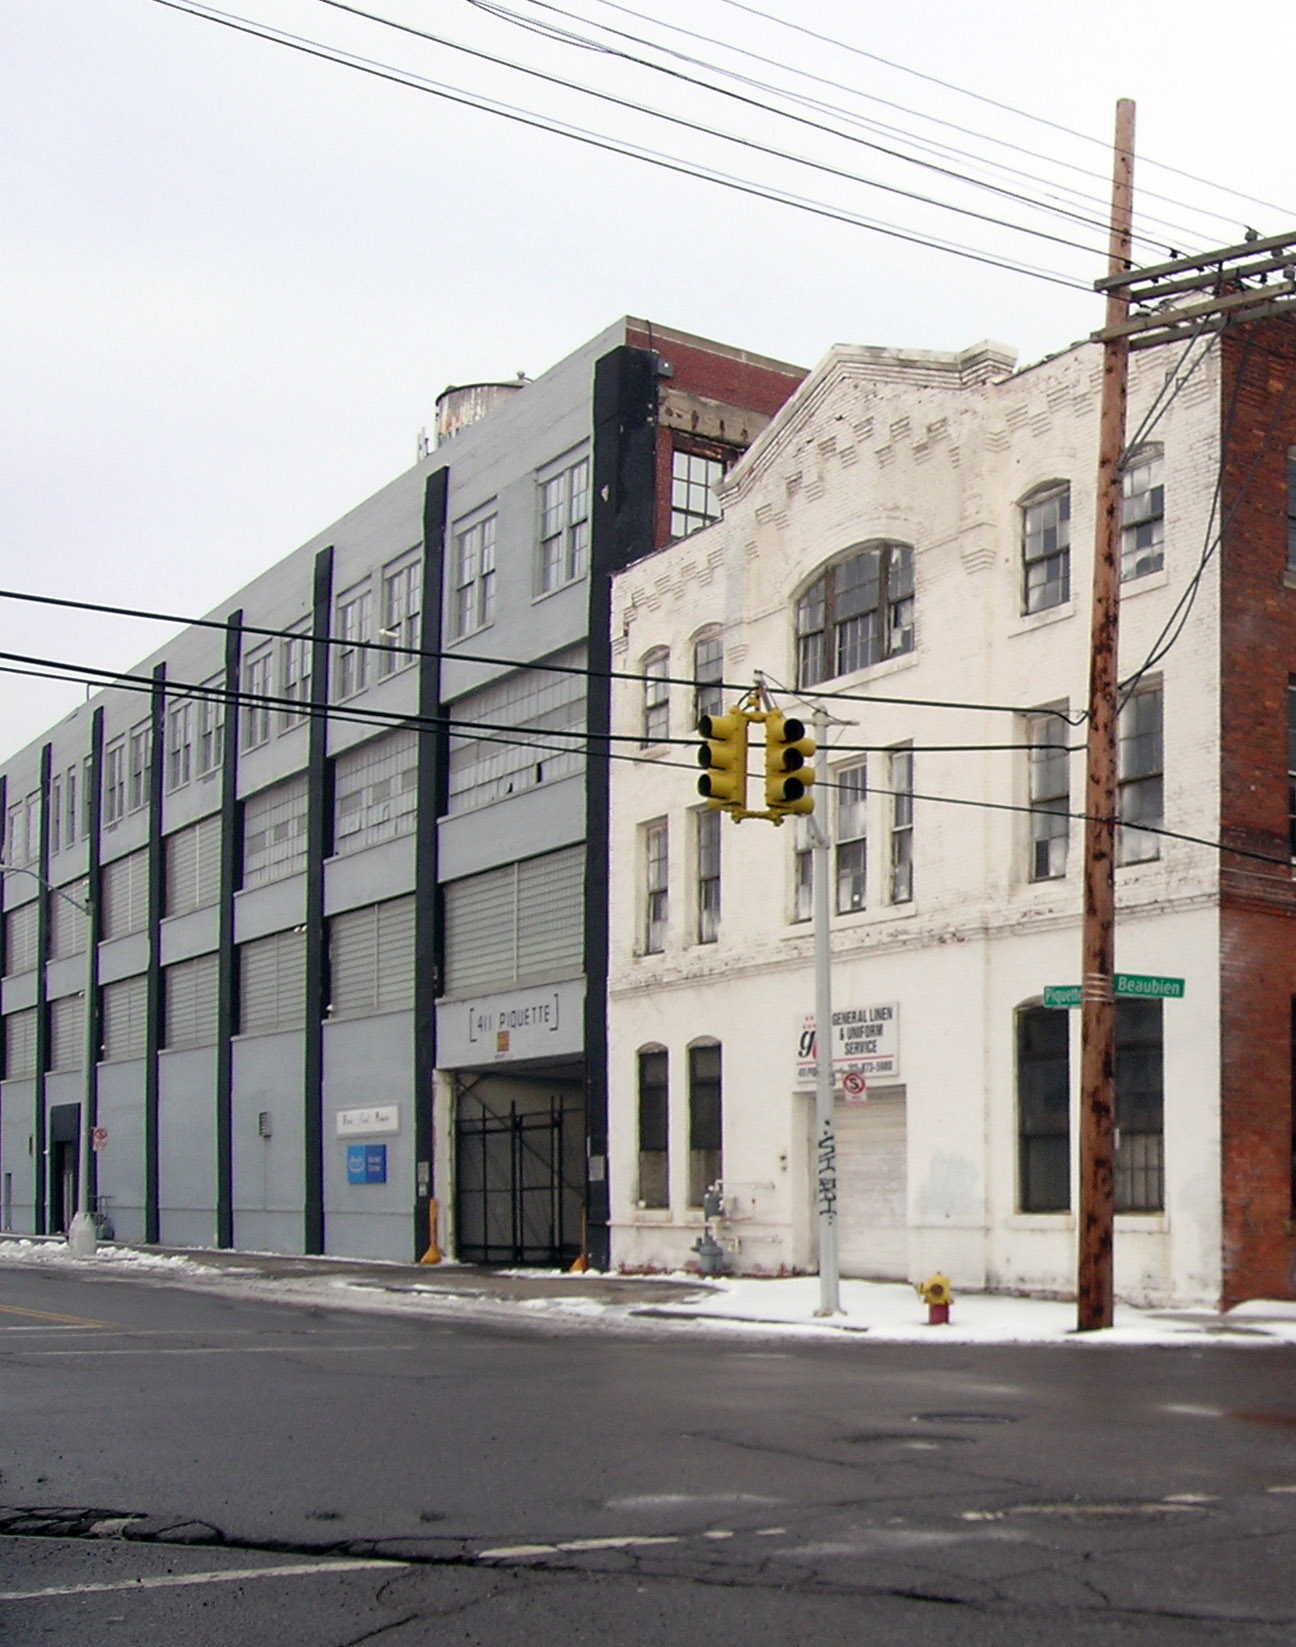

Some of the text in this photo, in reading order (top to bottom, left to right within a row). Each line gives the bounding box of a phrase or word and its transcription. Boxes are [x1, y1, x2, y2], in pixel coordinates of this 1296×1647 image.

[1118, 976, 1180, 995] Beaubien
[832, 1007, 893, 1026] GENERAL LINEN
[846, 1023, 883, 1040] UNIFORM
[844, 1040, 877, 1055] SERVICE
